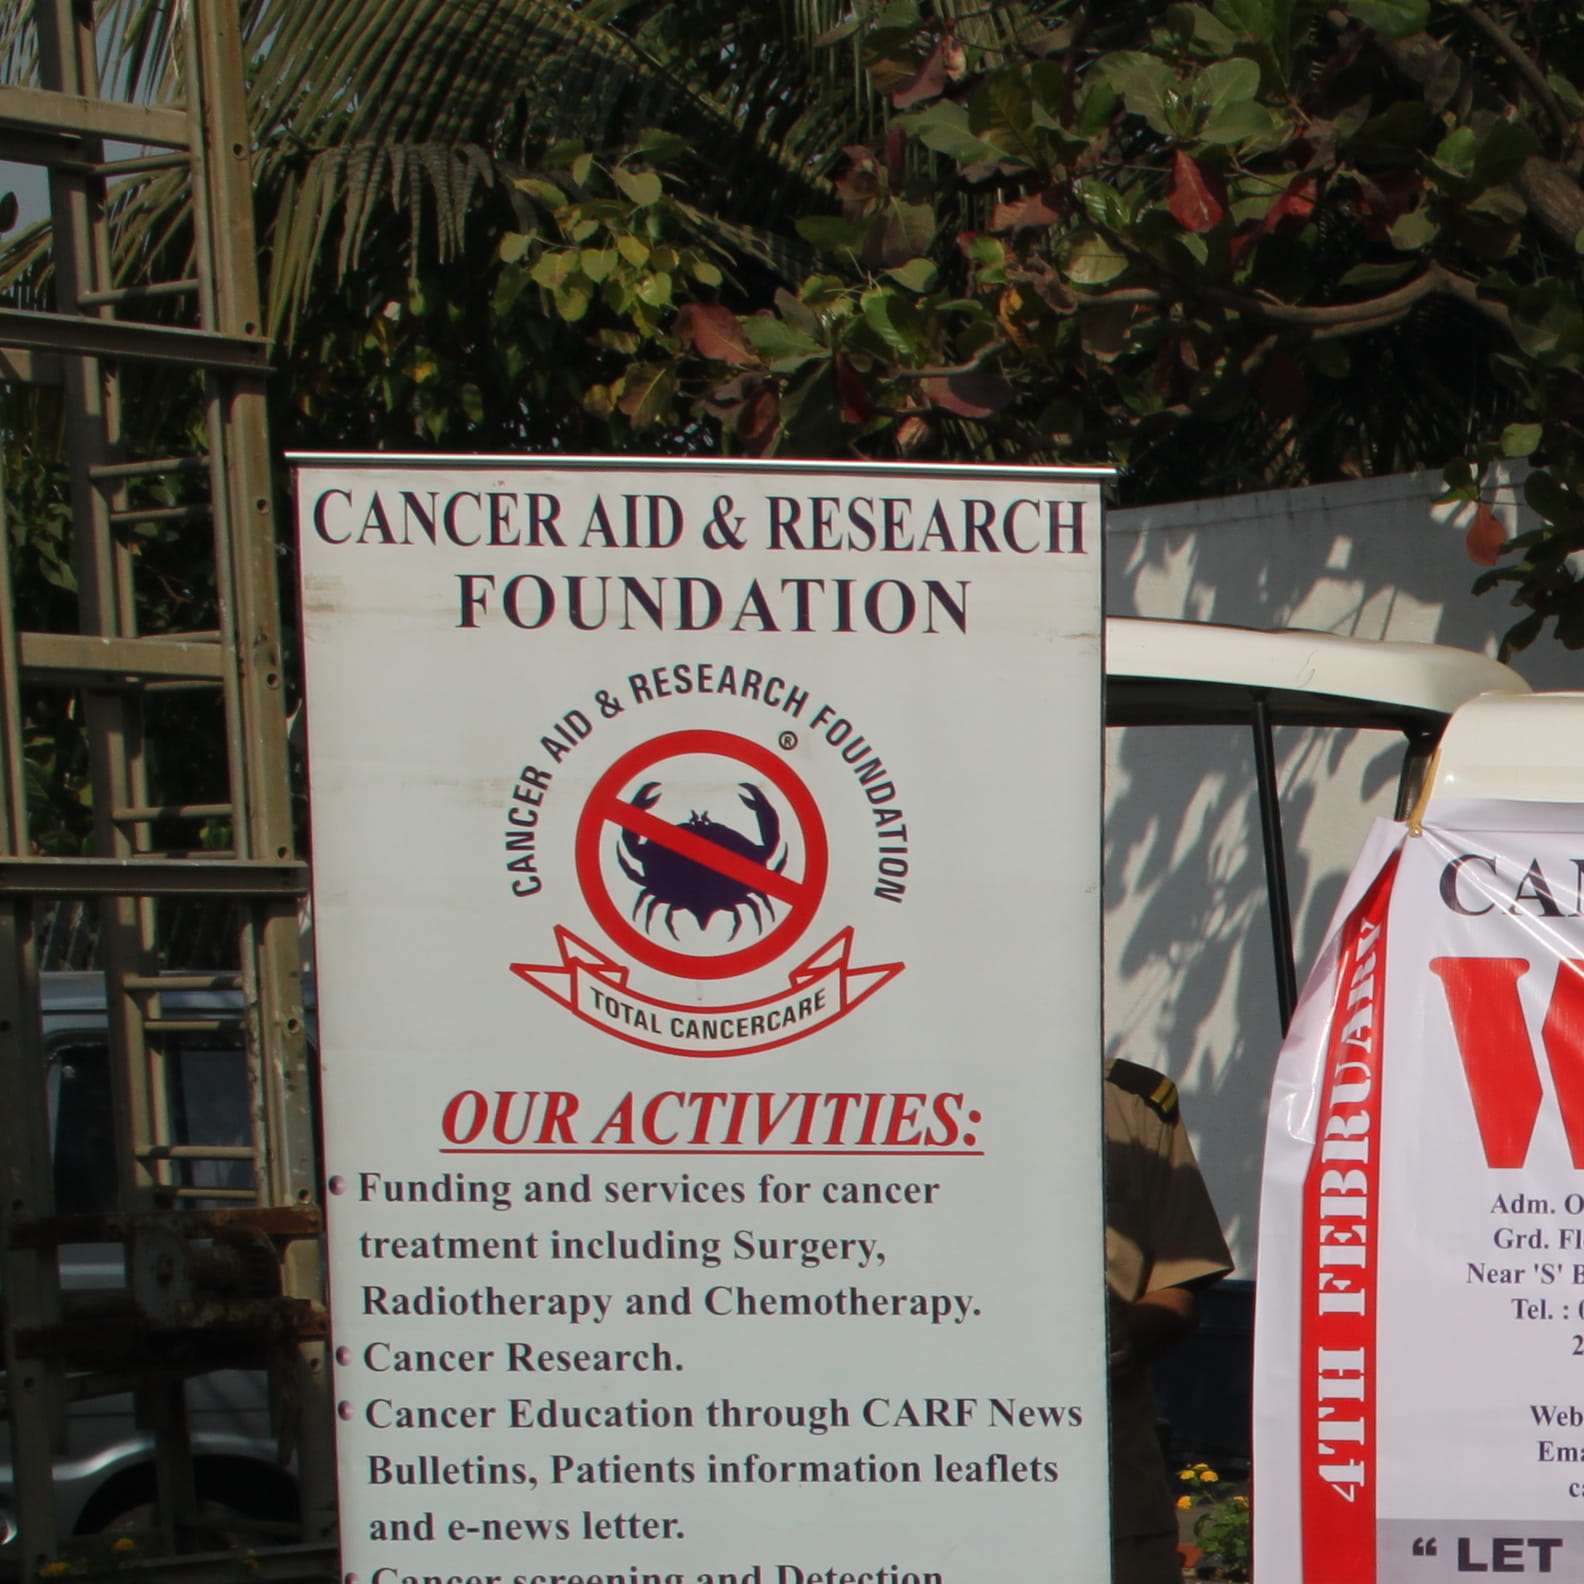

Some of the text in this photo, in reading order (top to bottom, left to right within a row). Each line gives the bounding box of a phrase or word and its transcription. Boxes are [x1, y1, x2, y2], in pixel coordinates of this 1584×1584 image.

[314, 489, 1088, 556] CANCER AID & RESEARCH
[458, 575, 972, 636] FOUNDATION
[506, 662, 909, 905] CANCER AID & RESEARCH FOUNDATION
[589, 985, 828, 1041] TOTAL CANCERCARE
[442, 1090, 983, 1148] OUR ACTIVITIES:
[360, 1173, 942, 1213] Funding and services for cancer
[1316, 916, 1384, 1504] 4TH FEBRUARY
[360, 1230, 887, 1270] treatment including Surgery,
[1469, 1263, 1527, 1285] Near
[363, 1286, 982, 1326] Radiotherapy and Chemotherapy.
[364, 1342, 684, 1373] Cancer Research.
[366, 1398, 1084, 1437] Cancer Education through CARF News
[369, 1454, 1060, 1489] Bulletins, Patients information leaflets
[371, 1511, 686, 1542] and e-news letter.
[1411, 1536, 1438, 1556] “
[1456, 1536, 1563, 1573] LET
